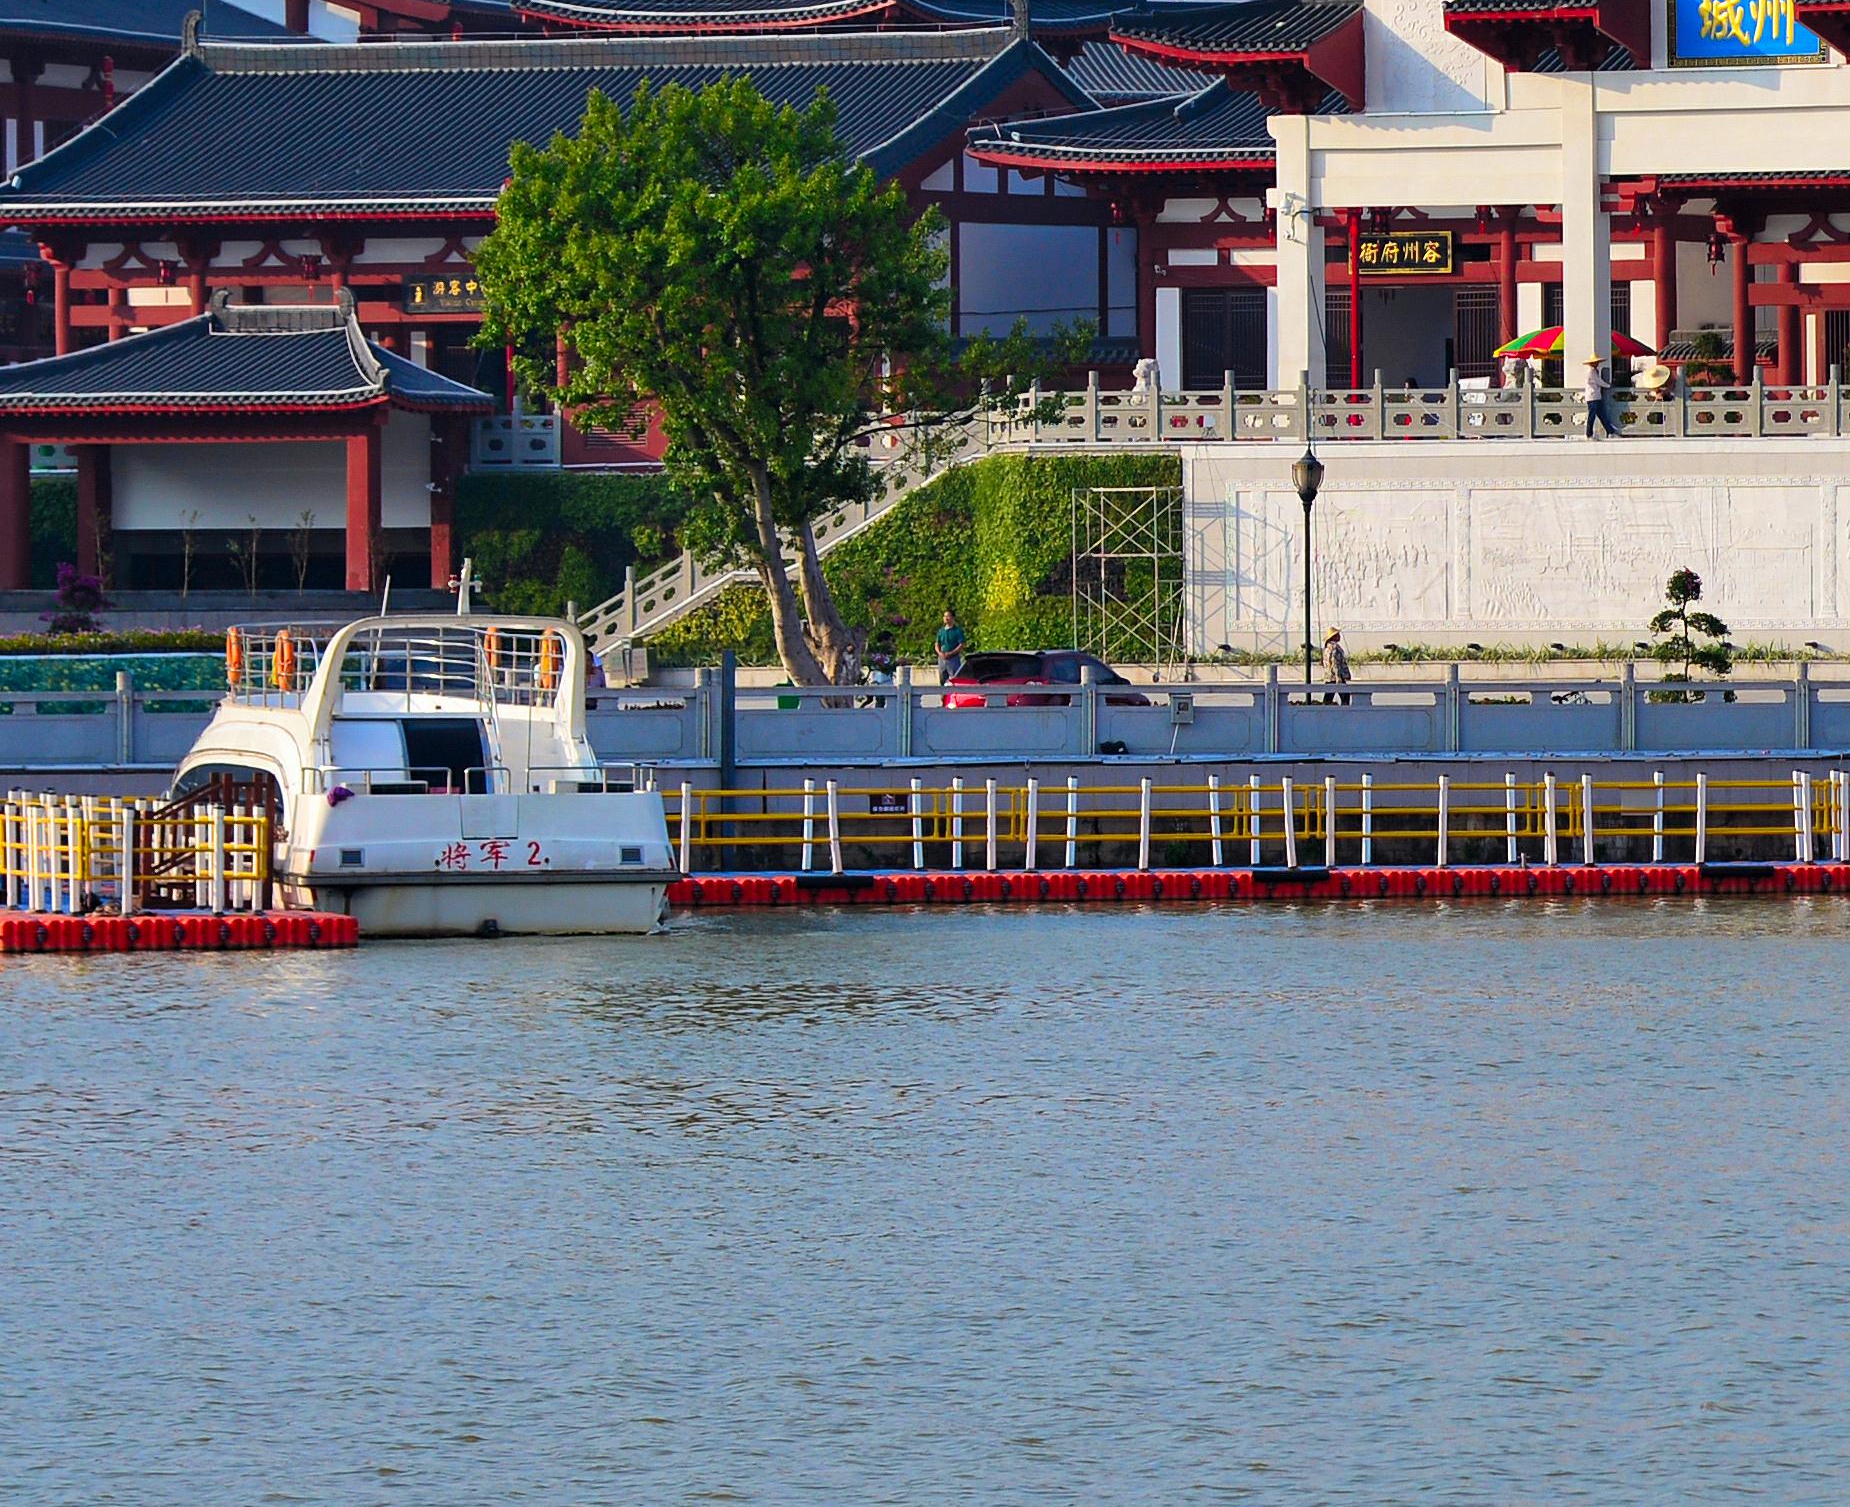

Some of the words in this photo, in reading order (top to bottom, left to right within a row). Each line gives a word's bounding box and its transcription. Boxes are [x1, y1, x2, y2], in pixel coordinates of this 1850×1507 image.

[432, 279, 486, 296] 游客中
[441, 841, 511, 869] 将军
[527, 841, 541, 865] 2
